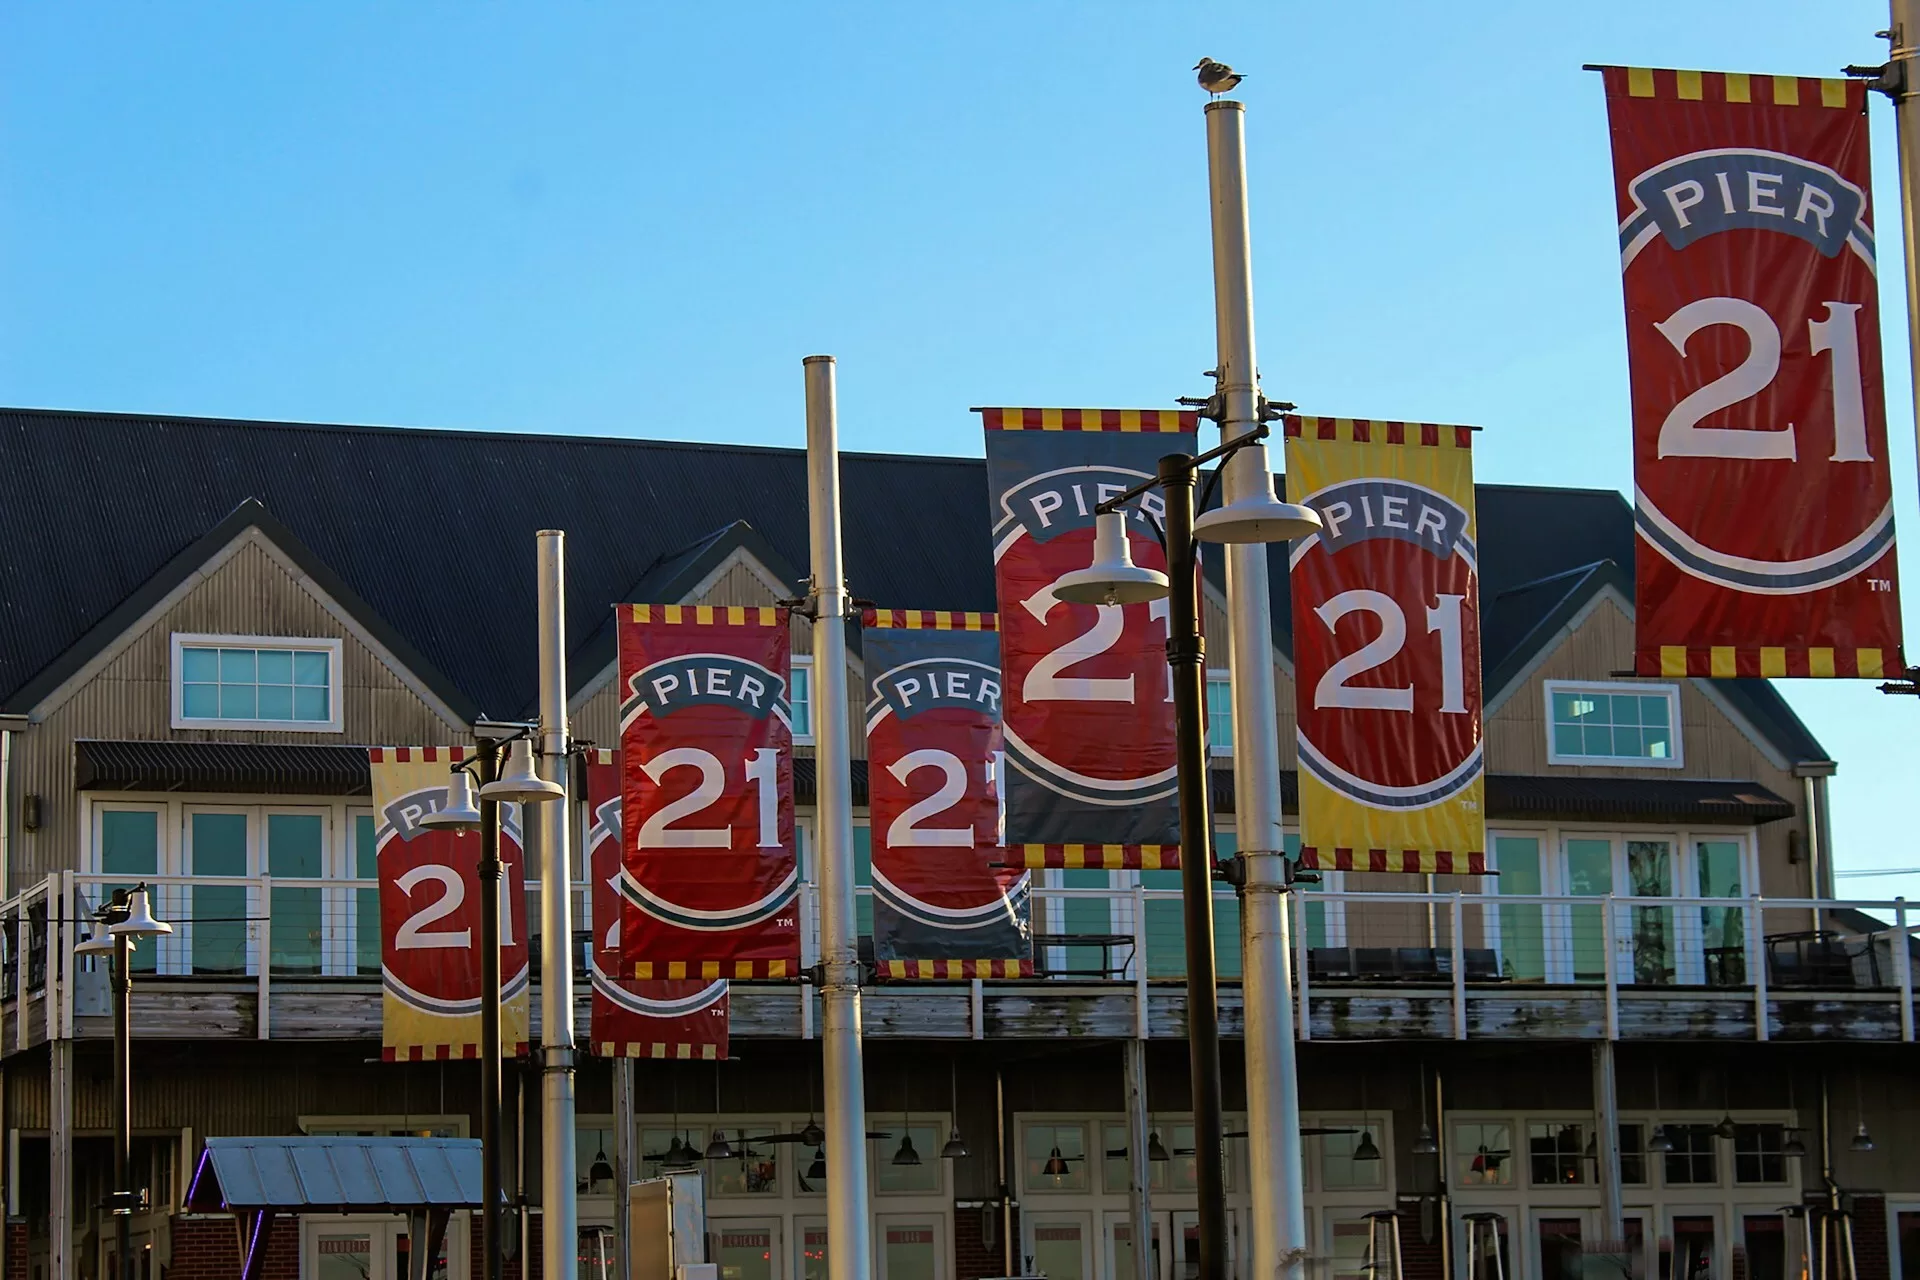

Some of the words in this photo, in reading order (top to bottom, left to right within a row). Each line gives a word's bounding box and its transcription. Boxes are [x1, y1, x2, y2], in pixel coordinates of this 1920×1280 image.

[1663, 170, 1837, 239] PIER
[1653, 296, 1874, 463] 21
[1322, 496, 1447, 544] PIER
[1313, 590, 1469, 714] 21
[652, 667, 766, 709] PIER
[894, 671, 1001, 712] PIER
[638, 747, 783, 850] 21
